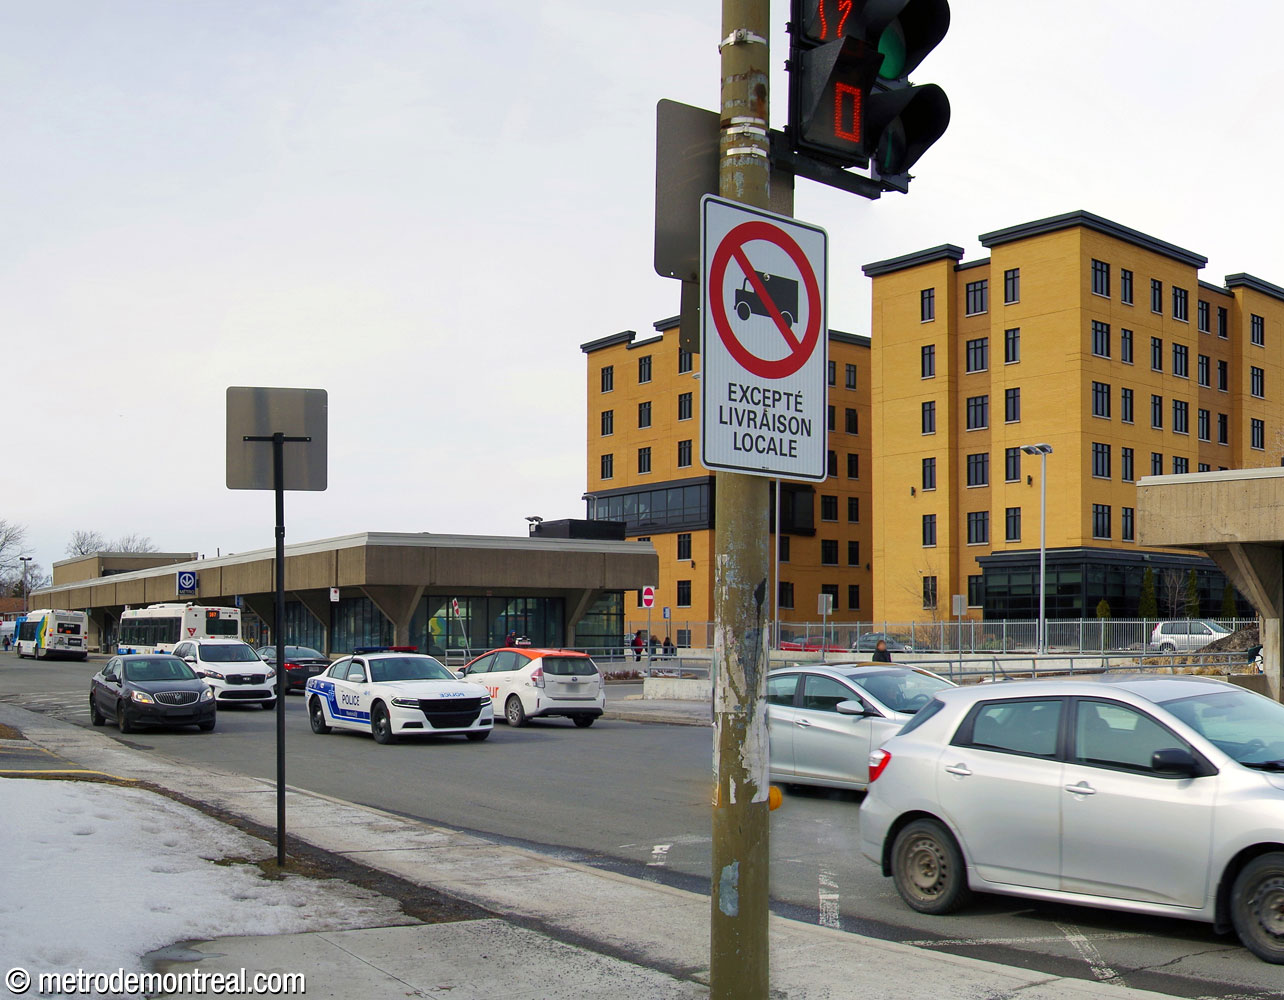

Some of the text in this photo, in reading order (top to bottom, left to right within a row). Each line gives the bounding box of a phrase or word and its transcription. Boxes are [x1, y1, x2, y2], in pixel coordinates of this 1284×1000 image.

[728, 382, 804, 413] EXCEPTÉ
[719, 405, 812, 437] LIVRAISON
[733, 431, 798, 458] LOCALE
[342, 694, 360, 706] POLICE
